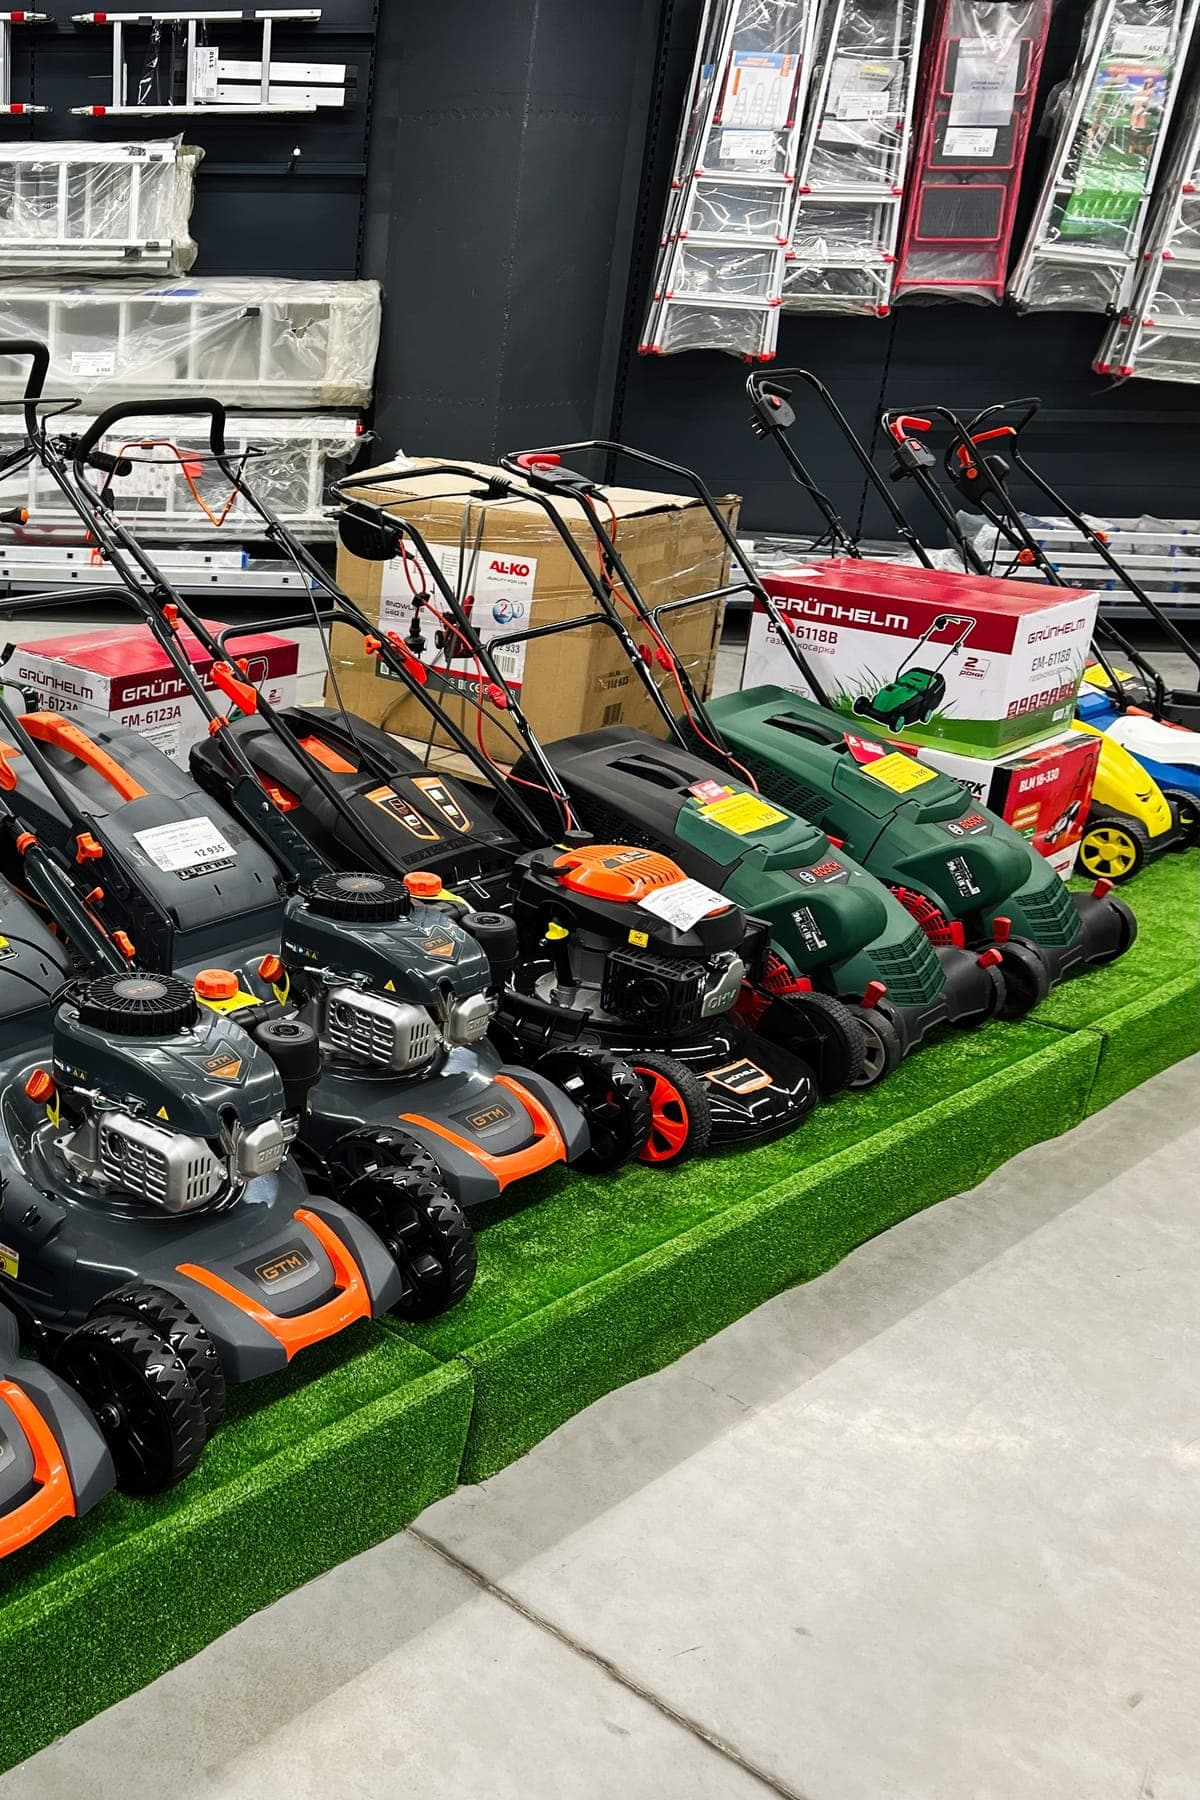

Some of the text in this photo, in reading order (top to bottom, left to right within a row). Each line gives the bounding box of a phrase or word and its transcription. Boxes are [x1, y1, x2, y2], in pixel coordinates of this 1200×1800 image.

[771, 596, 910, 630] GRÜNHELM
[1027, 618, 1086, 645] GRÜNHELM
[19, 667, 94, 700] GRÜNHELM
[810, 860, 843, 878] BOSCH
[473, 1108, 504, 1127] GTM
[263, 1256, 302, 1280] GTM
